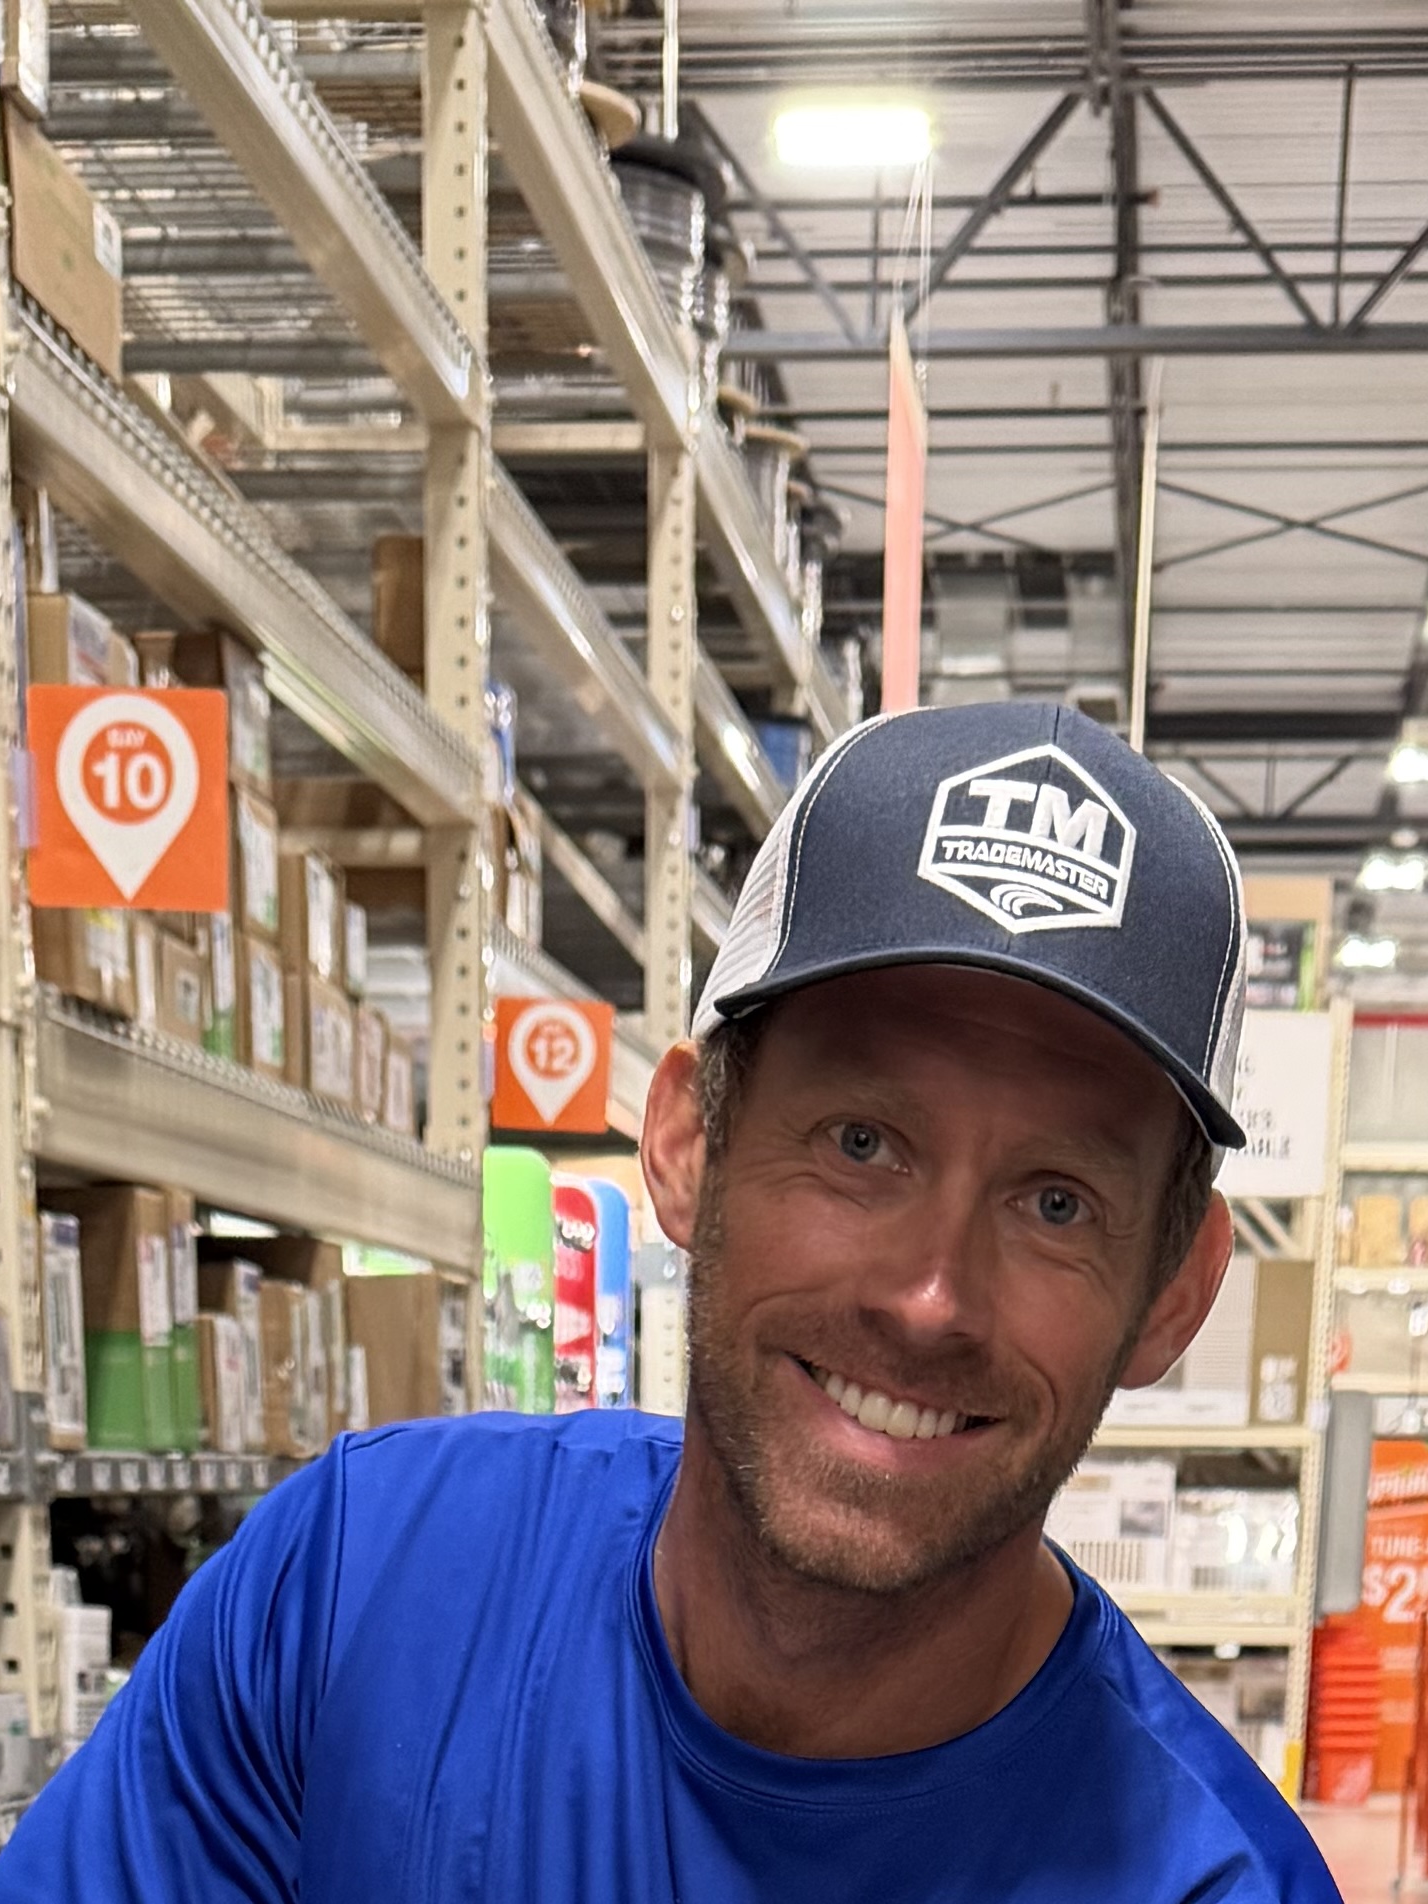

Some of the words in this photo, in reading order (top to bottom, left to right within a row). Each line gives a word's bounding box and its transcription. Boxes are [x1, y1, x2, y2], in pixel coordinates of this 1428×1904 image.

[106, 728, 148, 749] BAY
[91, 751, 167, 810] 10
[969, 779, 1109, 858] TM
[942, 839, 1109, 900] TRADEMASTER
[530, 1036, 577, 1072] 12
